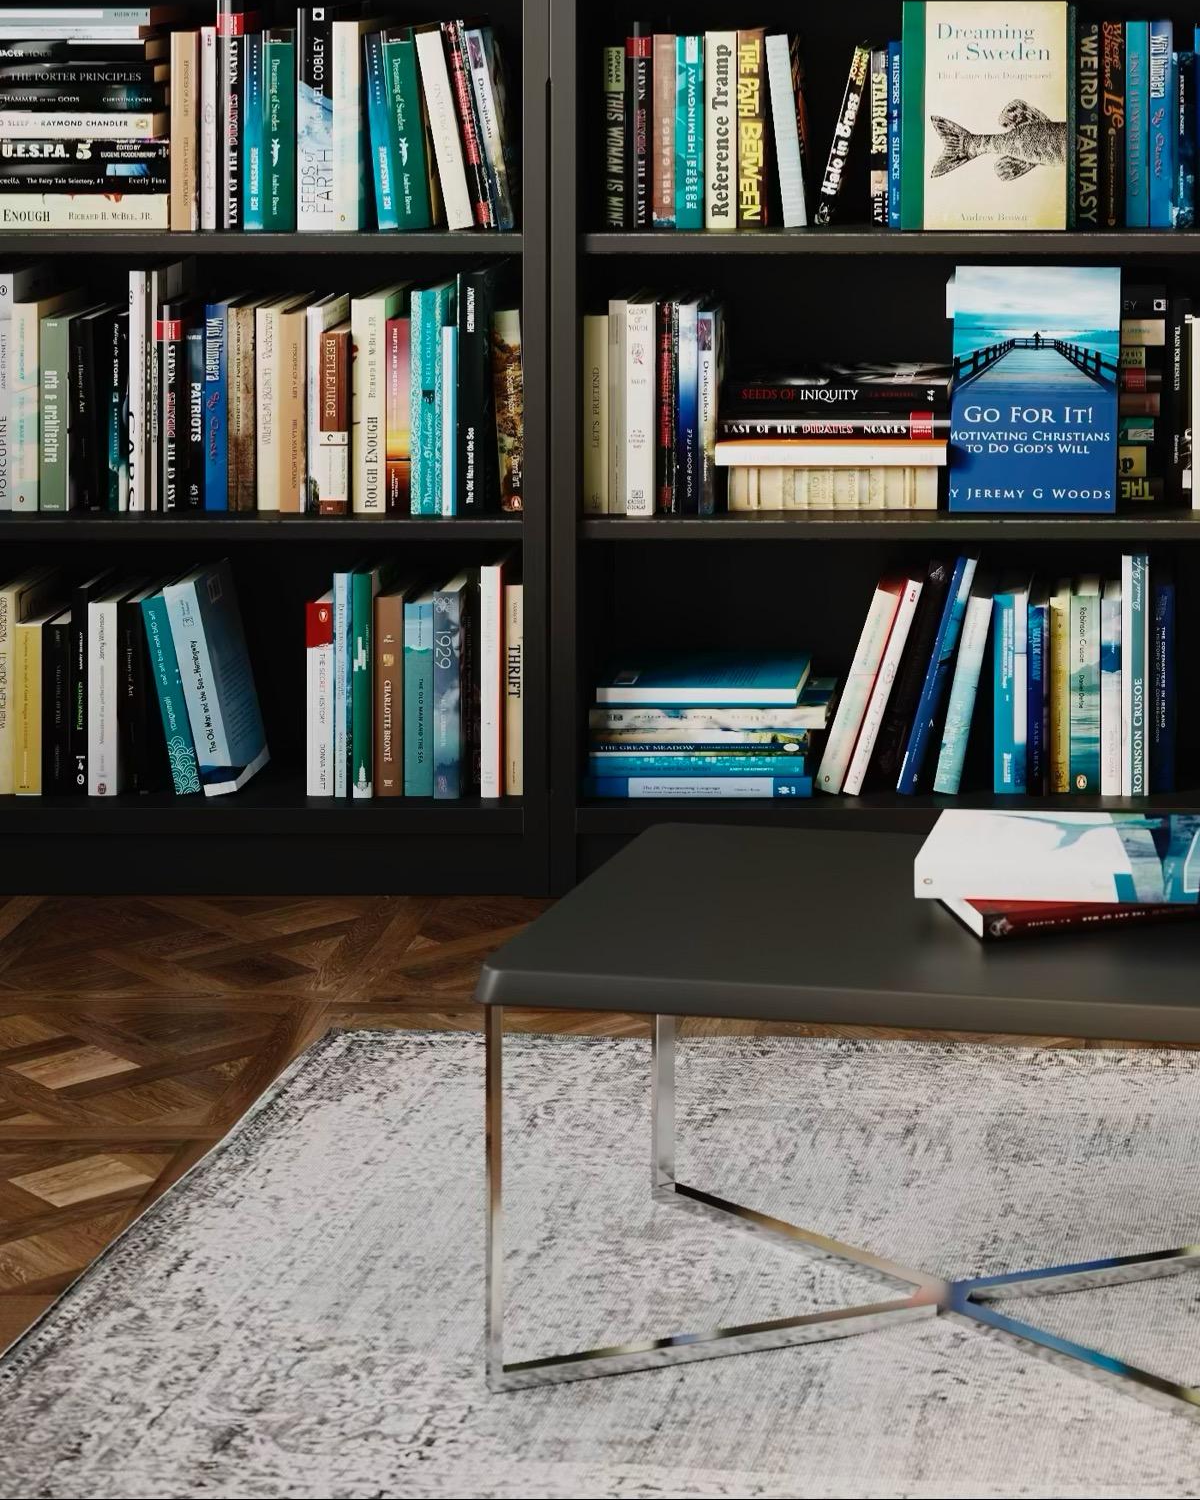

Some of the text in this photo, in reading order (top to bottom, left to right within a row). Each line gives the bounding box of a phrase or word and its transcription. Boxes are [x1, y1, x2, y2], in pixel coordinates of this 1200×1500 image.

[938, 23, 1035, 44] Dreaming
[948, 43, 1050, 61] of Sweden
[1103, 22, 1113, 90] Shadows
[1112, 23, 1125, 70] Where
[11, 72, 141, 81] THE PORTER PRINCIPLES
[314, 38, 323, 80] COBLEY
[477, 78, 493, 139] Draksjukan
[607, 93, 623, 121] THIS
[688, 67, 696, 152] HEMINGWAY
[737, 40, 762, 220] THE PATH BETWEEN
[871, 73, 887, 154] STAIRCASE
[1080, 36, 1097, 222] WEIRD FANTASY
[2, 142, 91, 159] U.E.S.P.A. 5
[607, 127, 623, 173] WOMAN
[711, 44, 731, 217] Reference Tramp
[608, 180, 623, 191] IS
[4, 209, 50, 221] ENOUGH
[326, 340, 336, 417] BEETLEJUICE
[190, 383, 202, 441] PATRIOTS
[964, 407, 1093, 424] GO FOR IT!
[951, 431, 1110, 442] MOTIVATING CHRISTIANS
[966, 444, 1090, 454] TO DO GOD'S WILL
[365, 417, 378, 508] ROUGH ENOUGH
[949, 489, 1111, 499] Y JEREMY G WOODS
[1079, 607, 1087, 637] Robinson
[436, 631, 451, 669] 1929
[508, 645, 521, 698] THRIFT
[1032, 628, 1041, 680] WALKAWAY
[1133, 678, 1142, 793] ROBINSON CRUSOE
